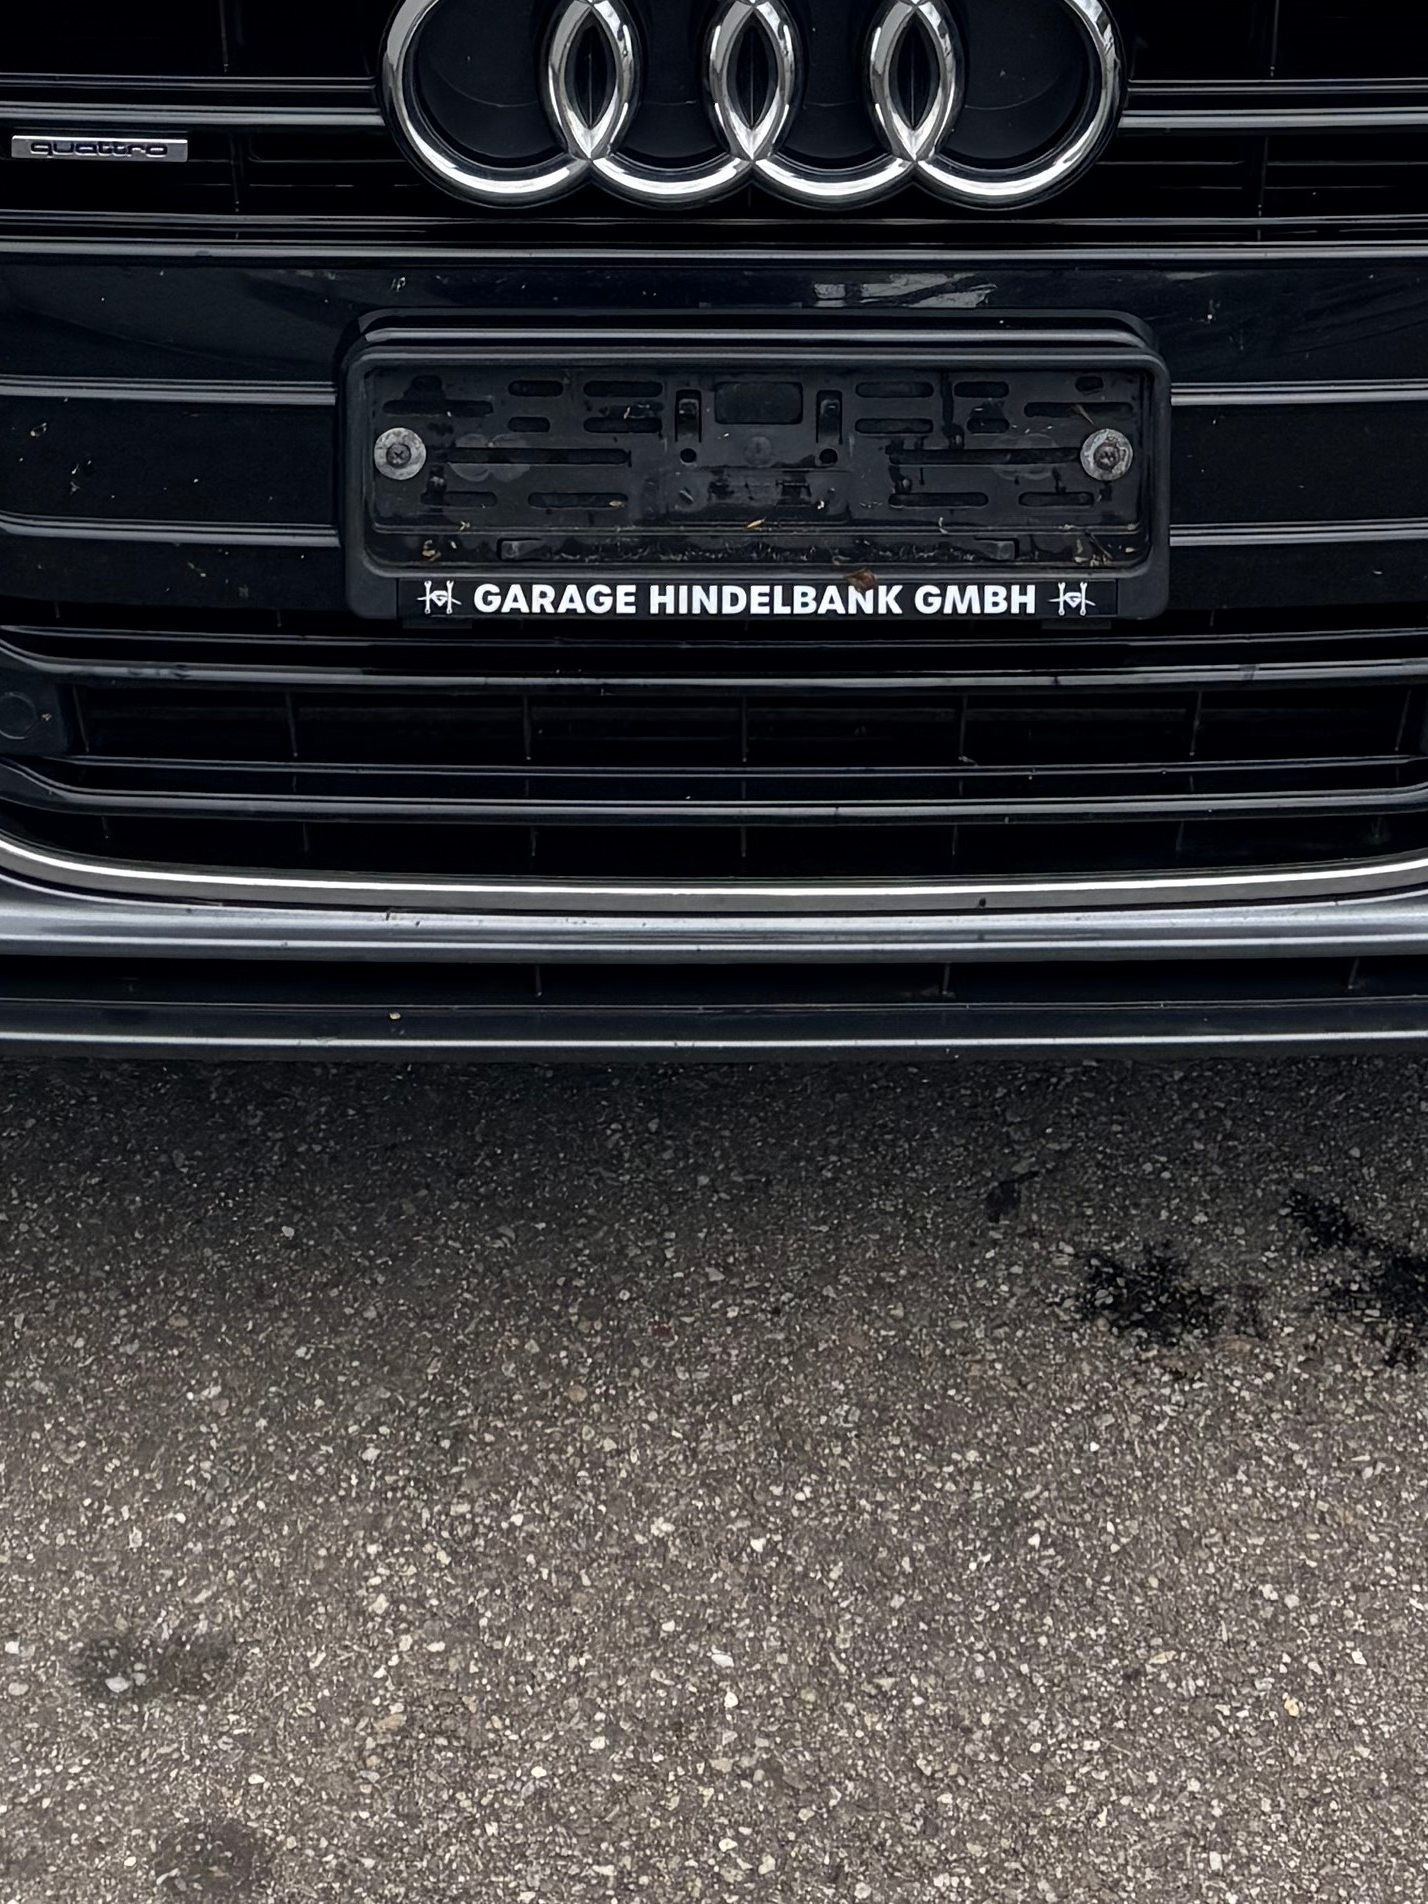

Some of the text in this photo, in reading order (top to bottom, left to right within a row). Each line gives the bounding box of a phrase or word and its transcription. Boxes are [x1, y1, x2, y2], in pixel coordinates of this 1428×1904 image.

[30, 141, 168, 160] quattro
[473, 583, 1036, 615] GARAGE HINDELBANK GMBH
